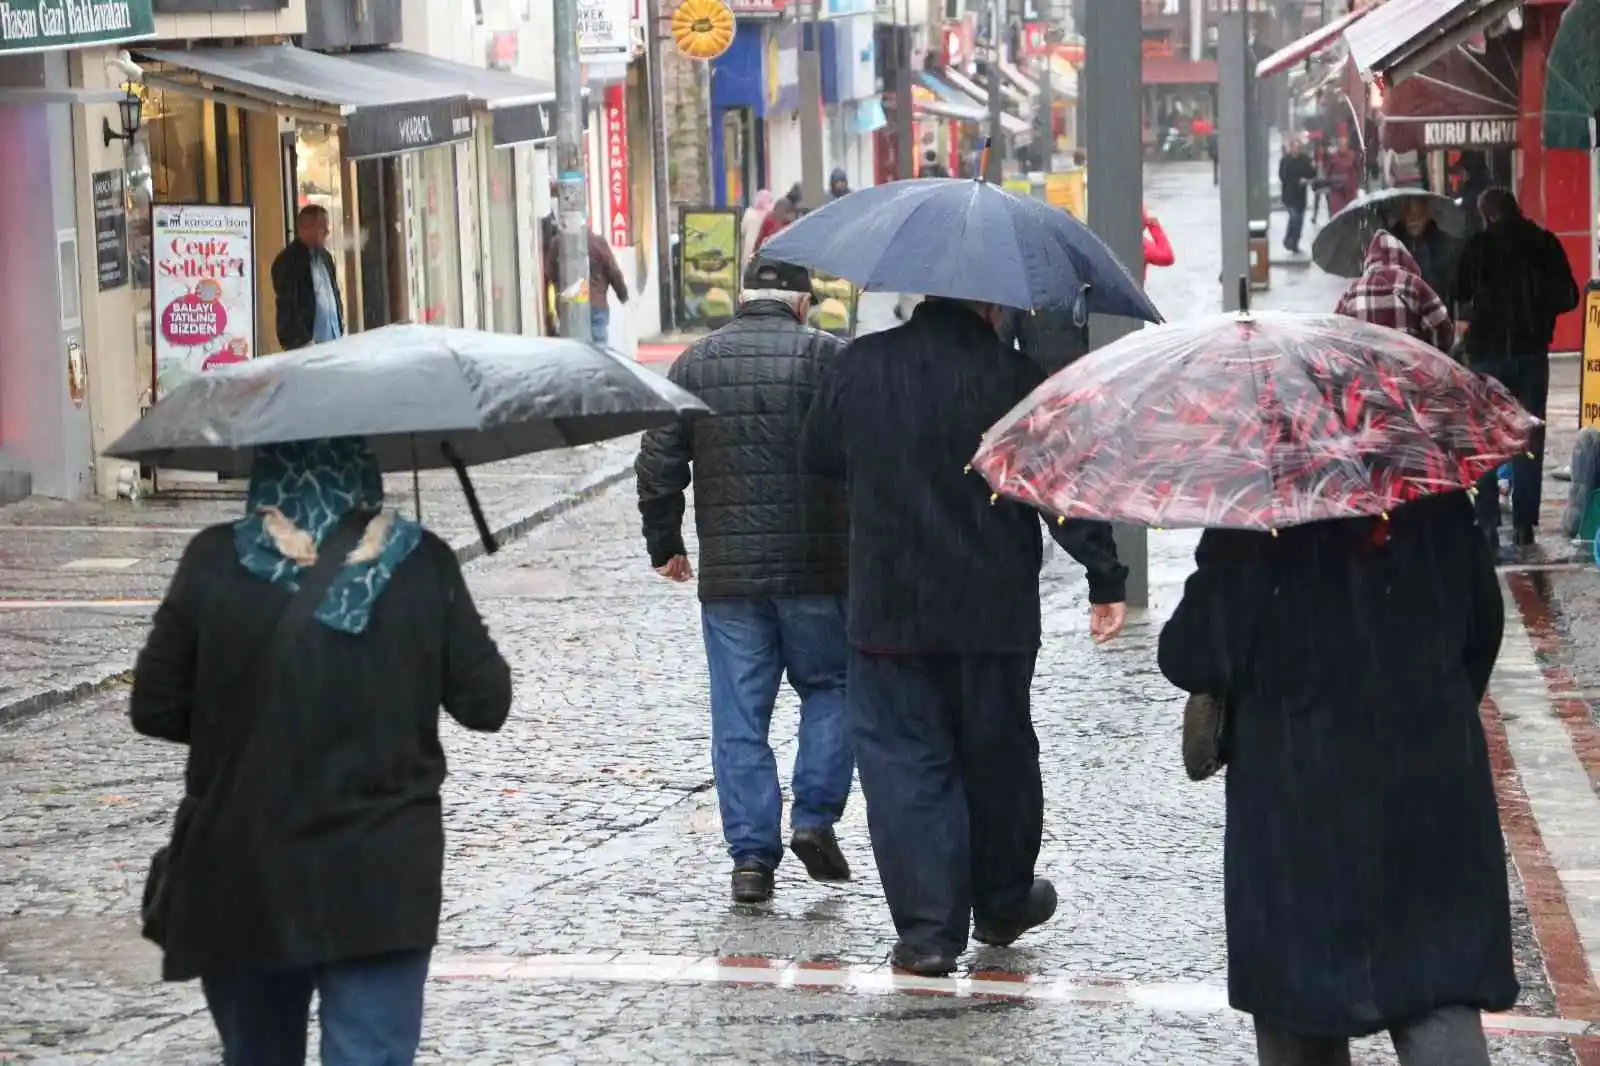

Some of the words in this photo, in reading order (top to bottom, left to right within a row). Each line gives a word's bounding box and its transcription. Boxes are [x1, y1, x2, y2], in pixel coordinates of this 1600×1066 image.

[1424, 121, 1466, 145] KURU
[610, 107, 623, 208] PHARMACY
[172, 302, 213, 313] BALAYI
